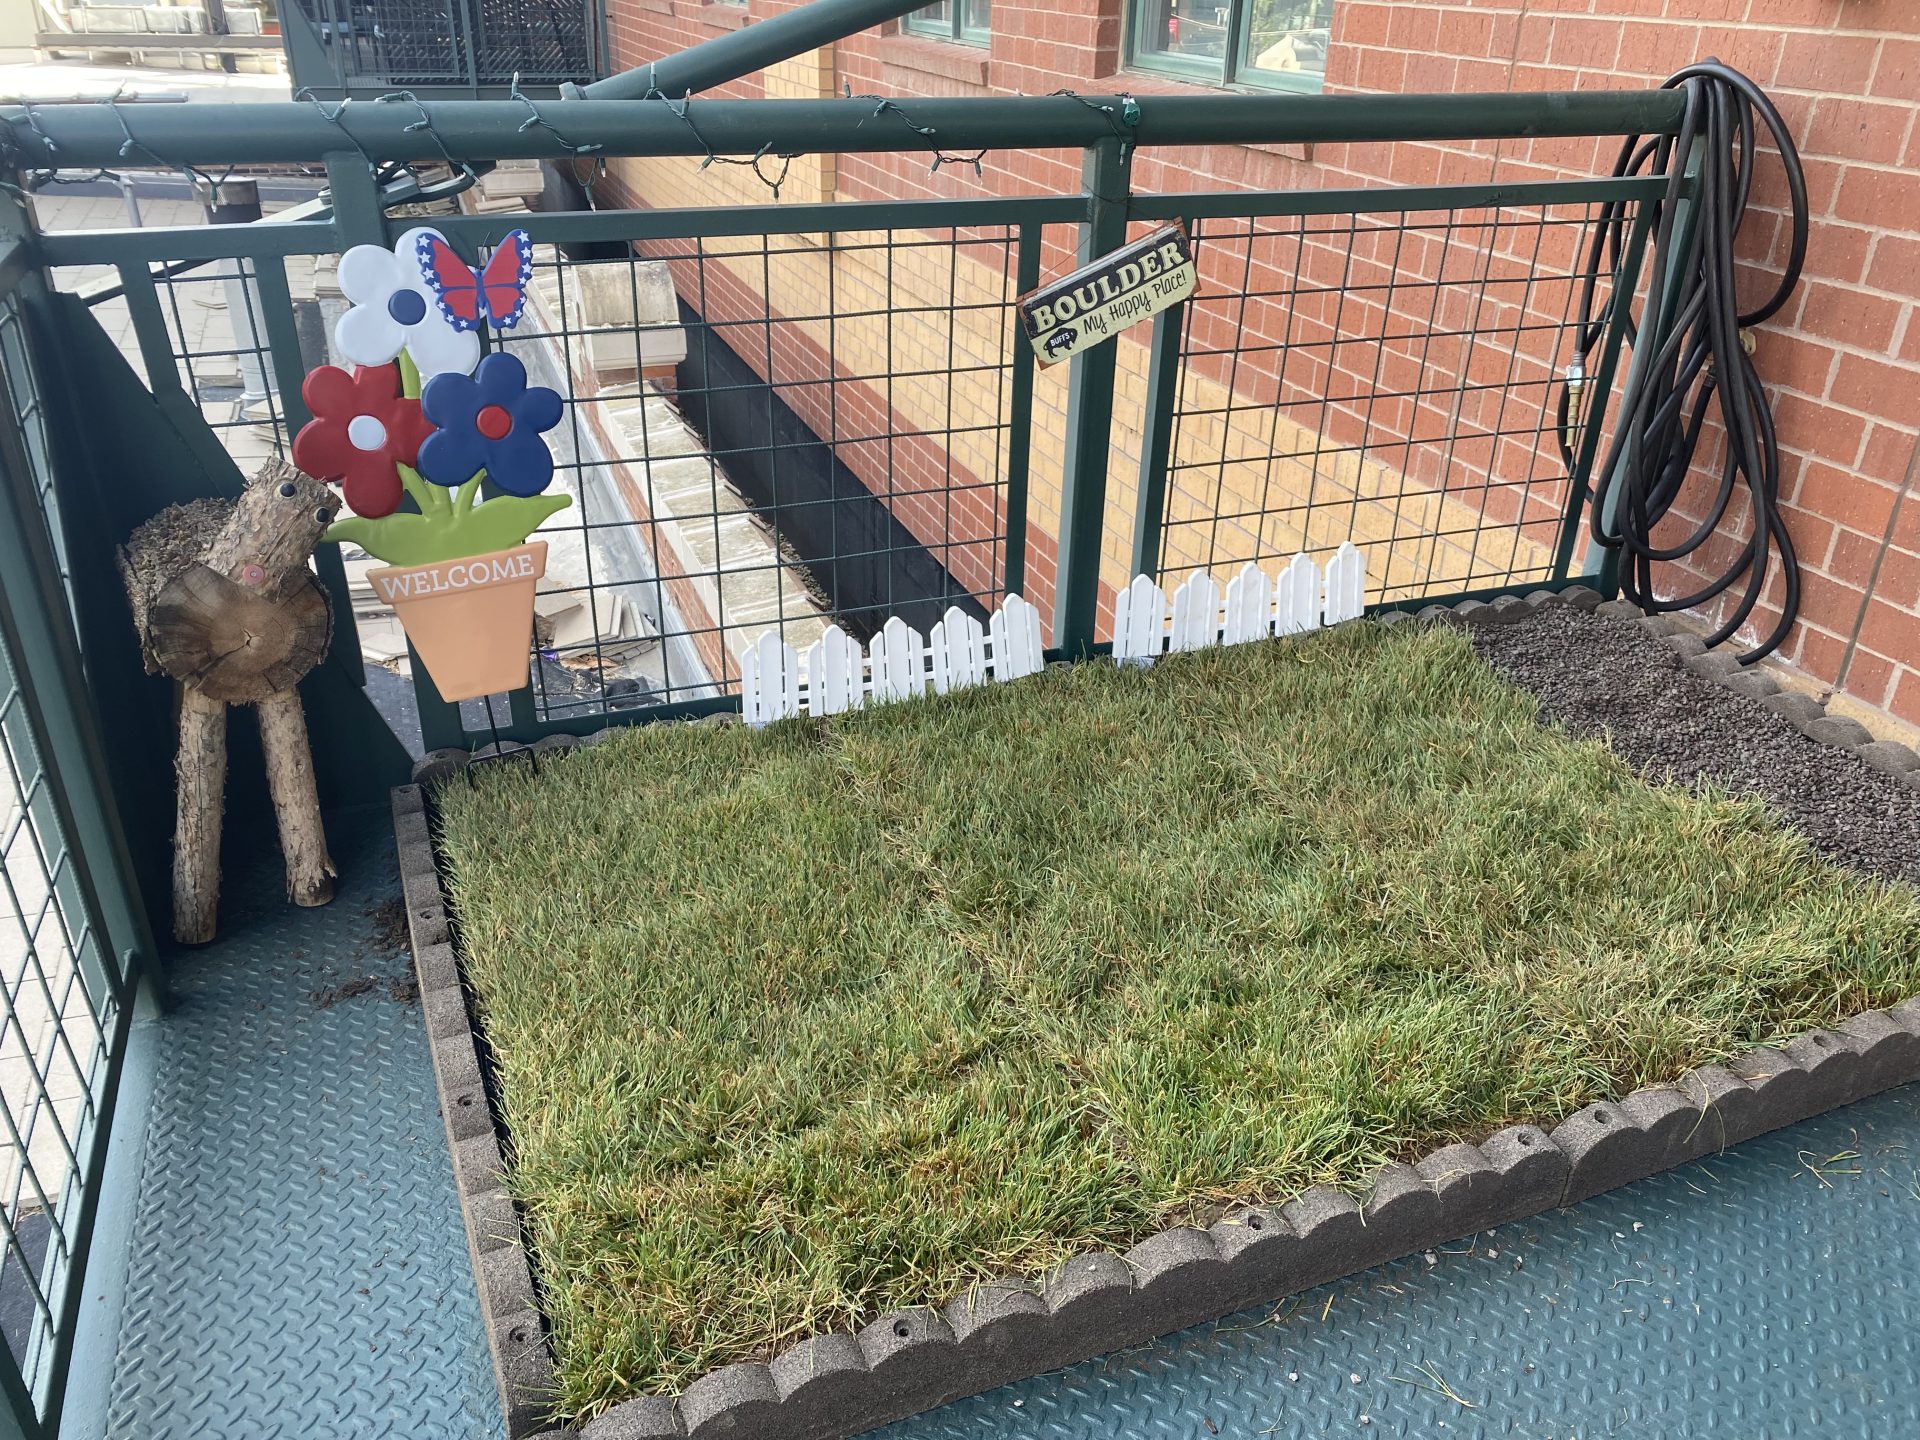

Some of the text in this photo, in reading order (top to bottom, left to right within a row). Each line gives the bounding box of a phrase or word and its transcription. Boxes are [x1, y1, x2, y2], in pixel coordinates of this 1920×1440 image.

[1031, 242, 1184, 332] BOULDER
[1083, 269, 1187, 334] My Happy Place!
[1050, 332, 1070, 347] BUFFS
[381, 554, 534, 599] WELCOME
